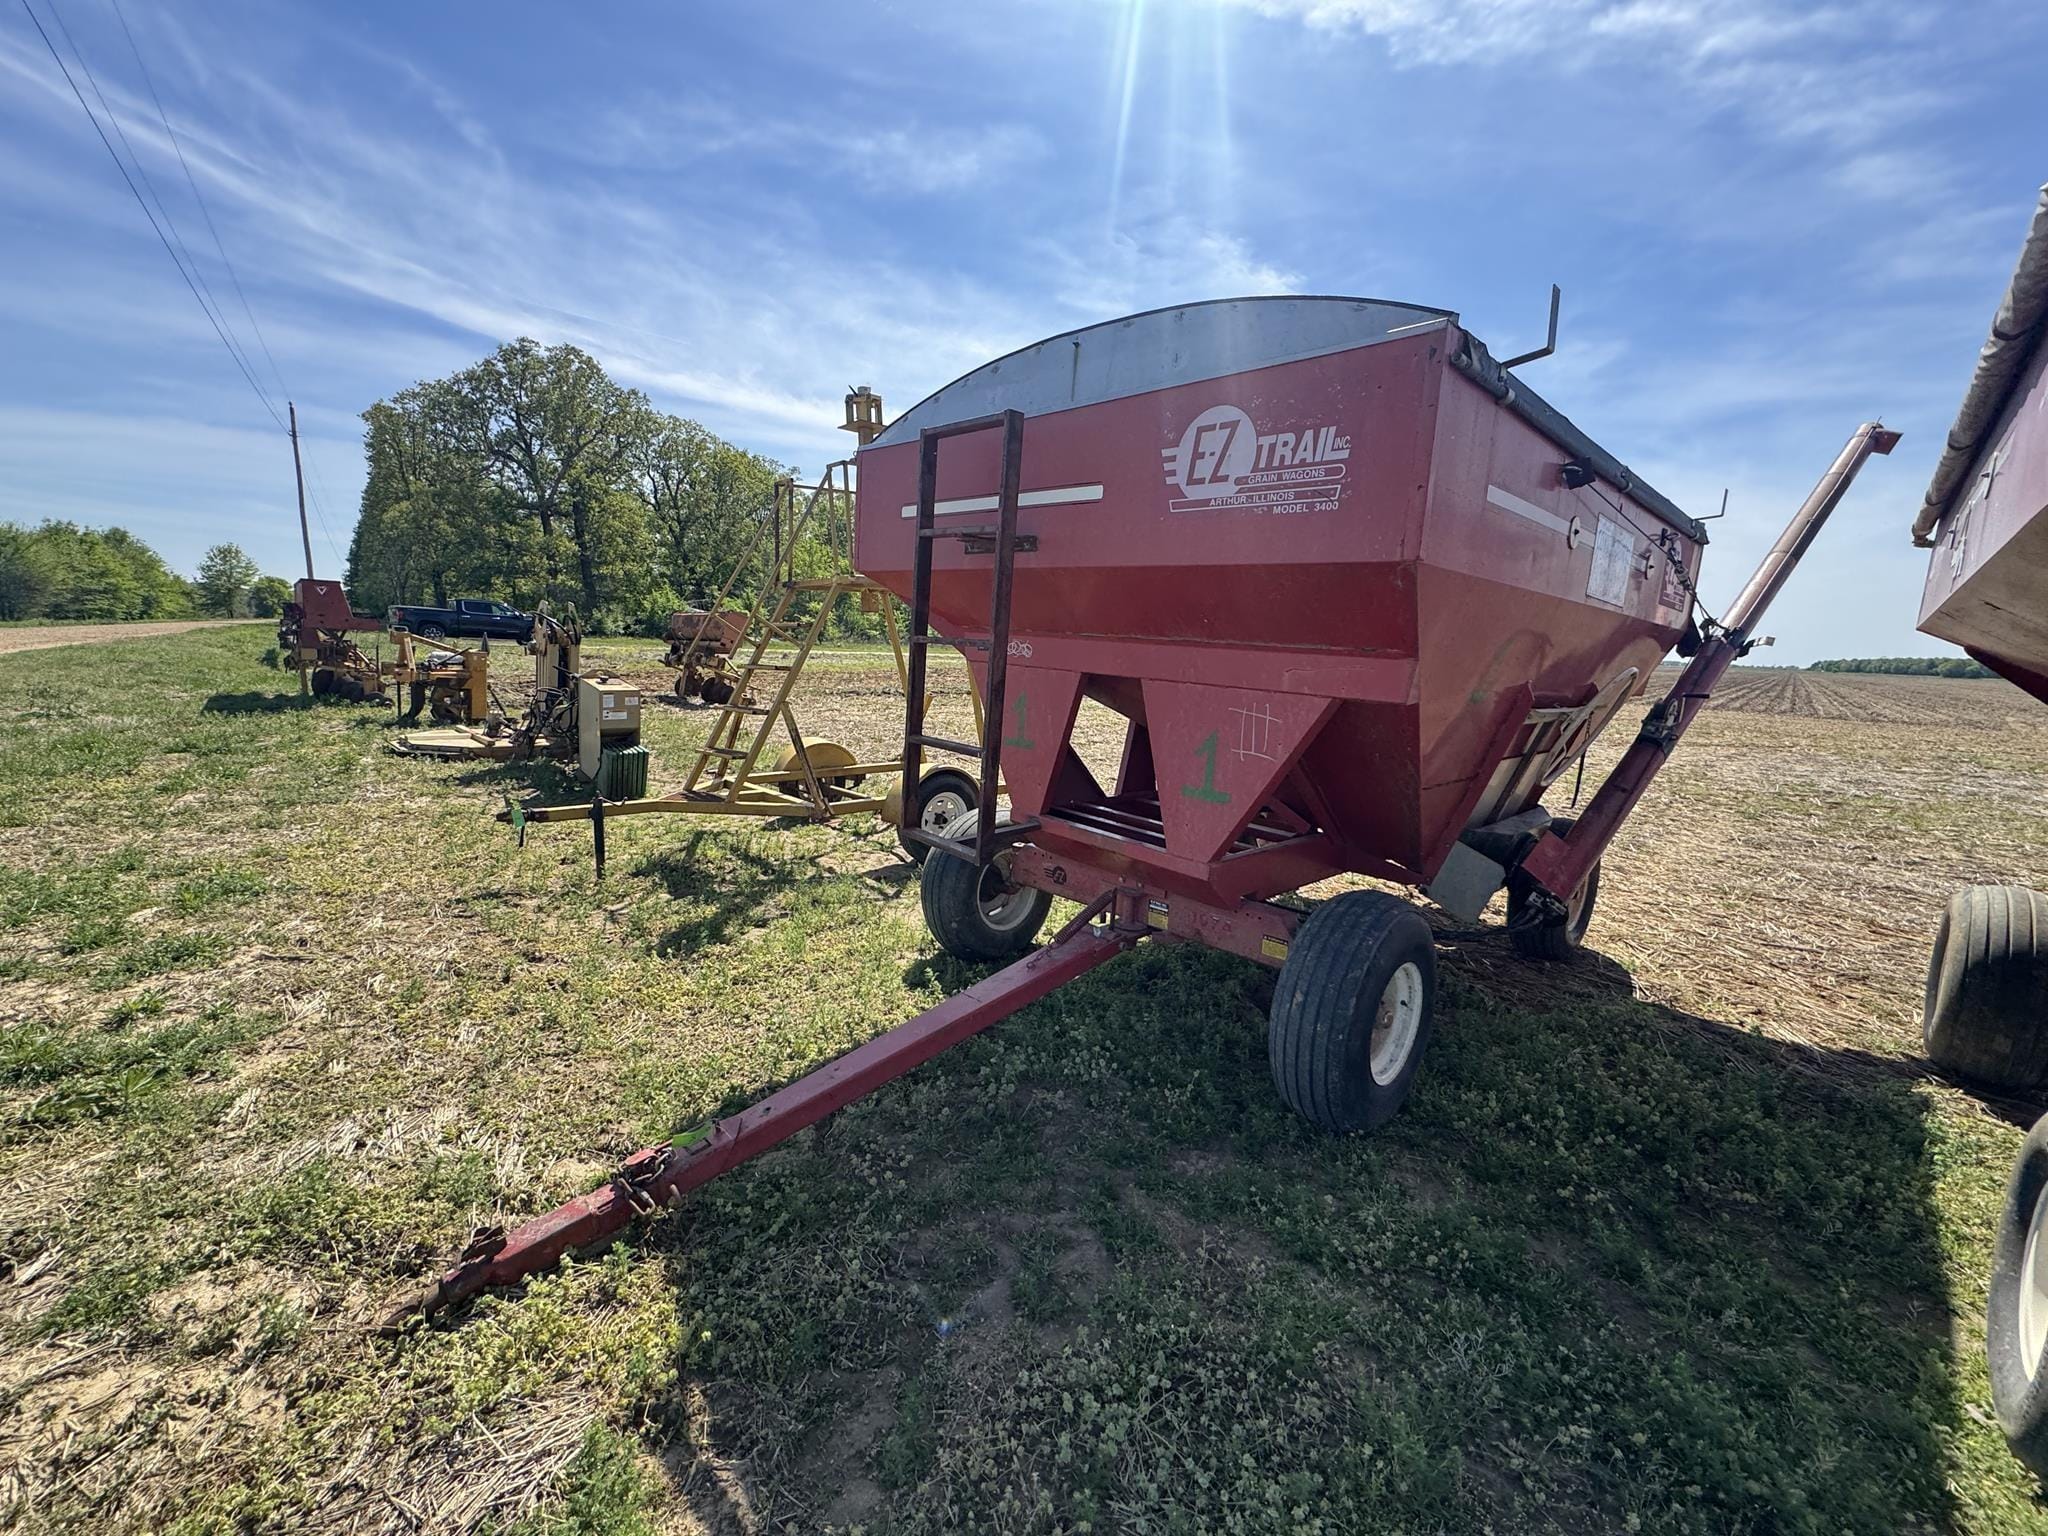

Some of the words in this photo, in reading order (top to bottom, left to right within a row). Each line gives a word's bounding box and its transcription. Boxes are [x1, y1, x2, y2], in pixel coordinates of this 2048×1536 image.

[1257, 425, 1350, 469] TRAIL
[1248, 472, 1278, 485] GRAIN
[1282, 468, 1326, 481] WAGONS
[1252, 491, 1295, 503] ILLINOIS
[1272, 503, 1309, 515] MODEL
[1314, 501, 1339, 511] 3400
[1004, 691, 1035, 749] 1
[1181, 729, 1232, 804] 1
